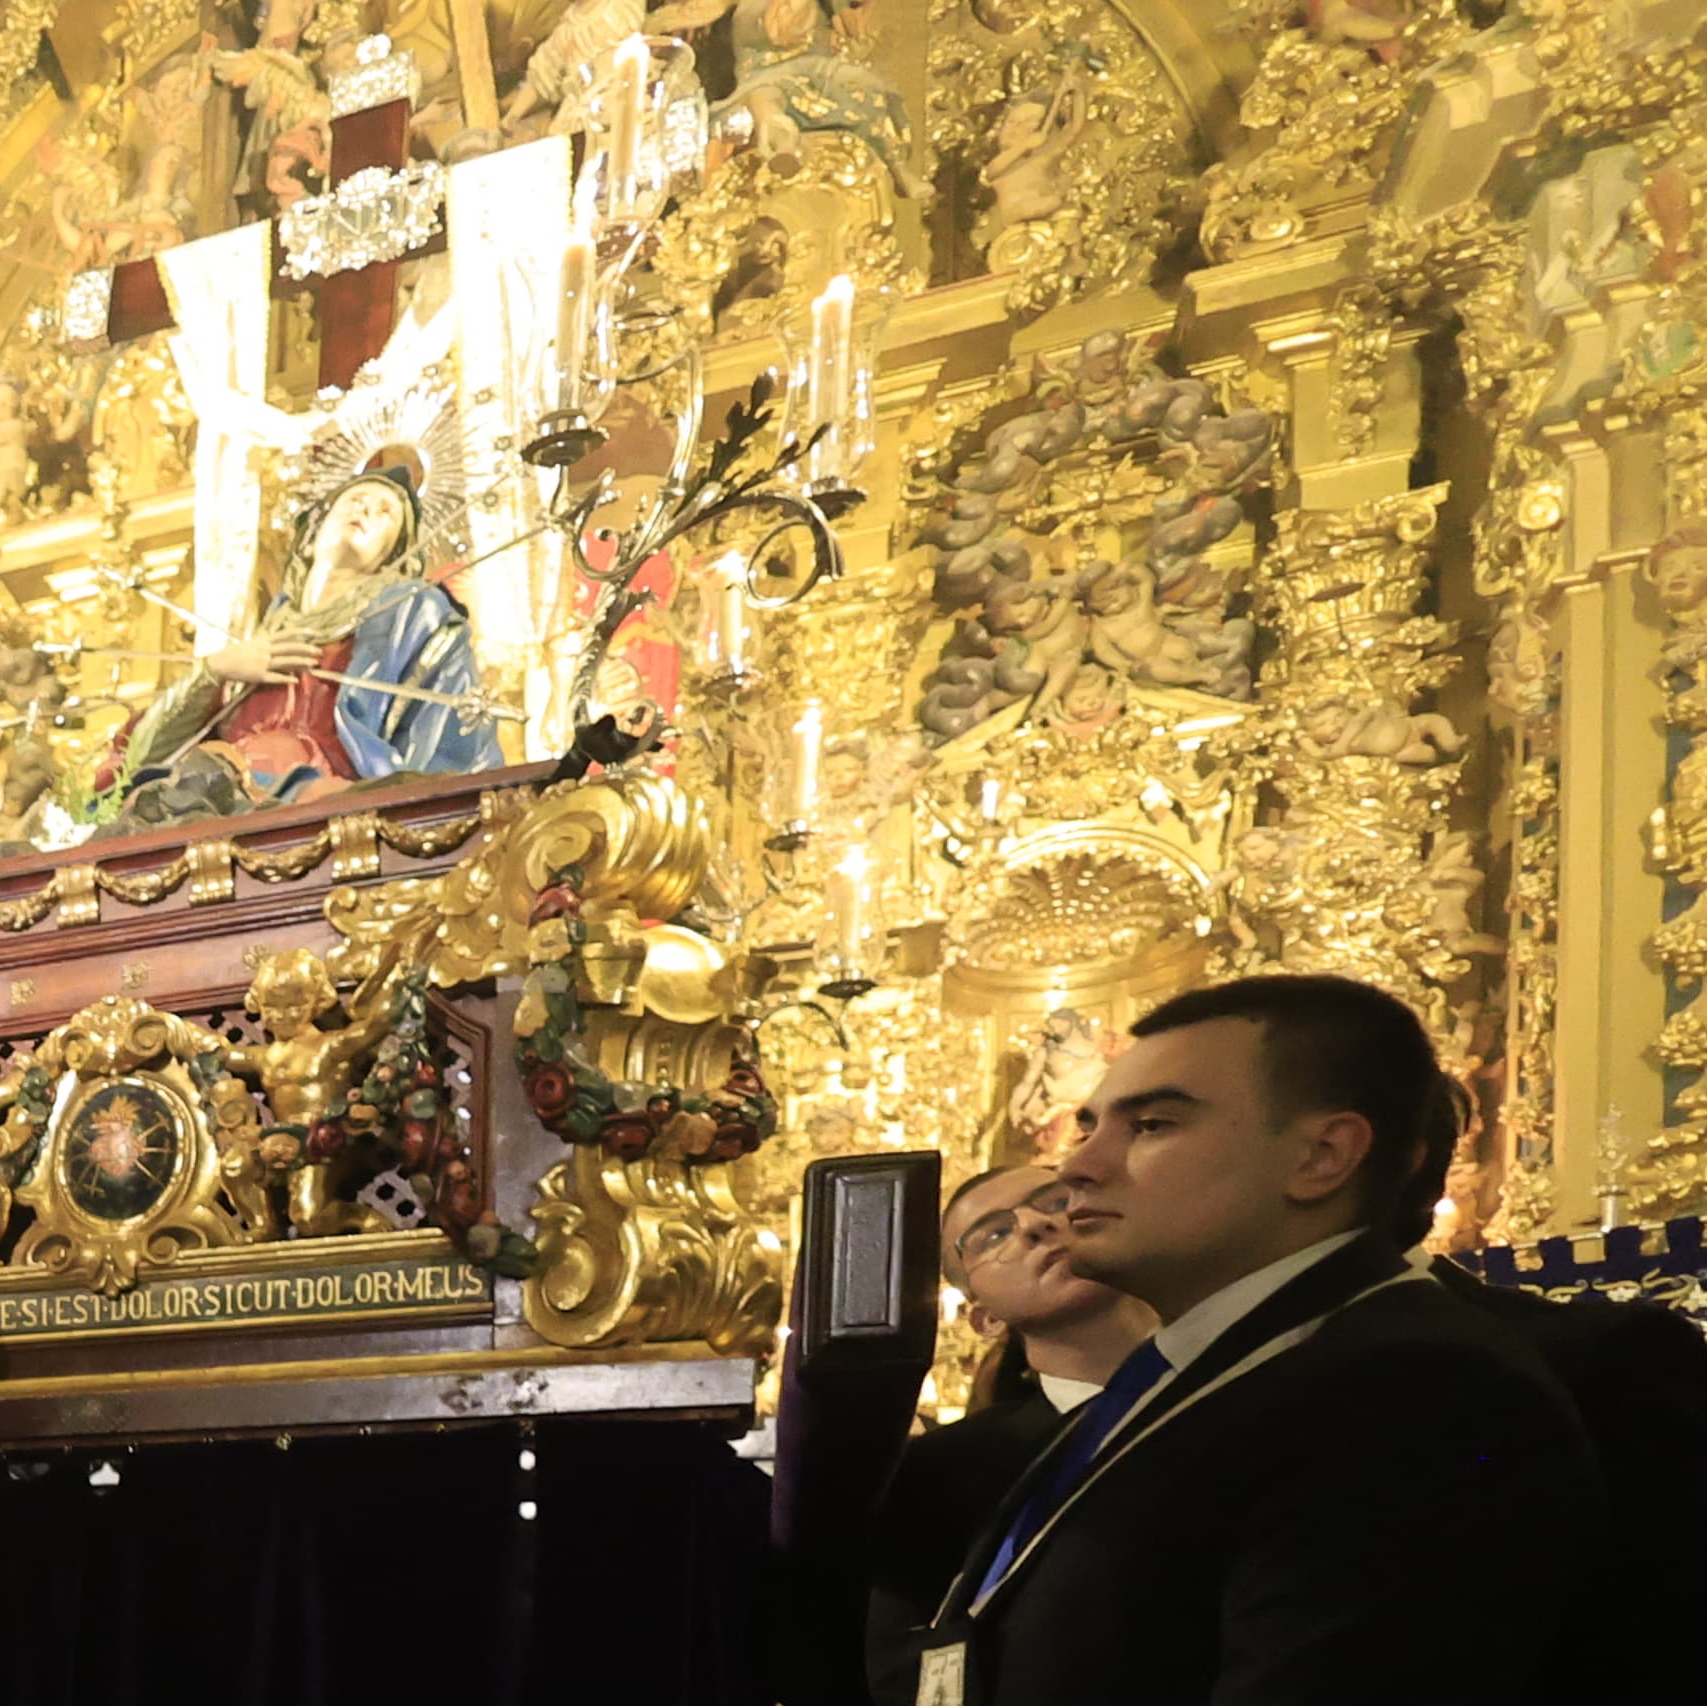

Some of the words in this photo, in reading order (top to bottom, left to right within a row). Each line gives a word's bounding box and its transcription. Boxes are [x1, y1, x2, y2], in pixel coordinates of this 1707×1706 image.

[21, 1299, 48, 1328] SI
[55, 1295, 102, 1325] EST
[110, 1286, 201, 1321] DOLOR
[204, 1279, 292, 1315] SICUT
[296, 1271, 396, 1308] DOLOR
[398, 1264, 483, 1301] MEUS
